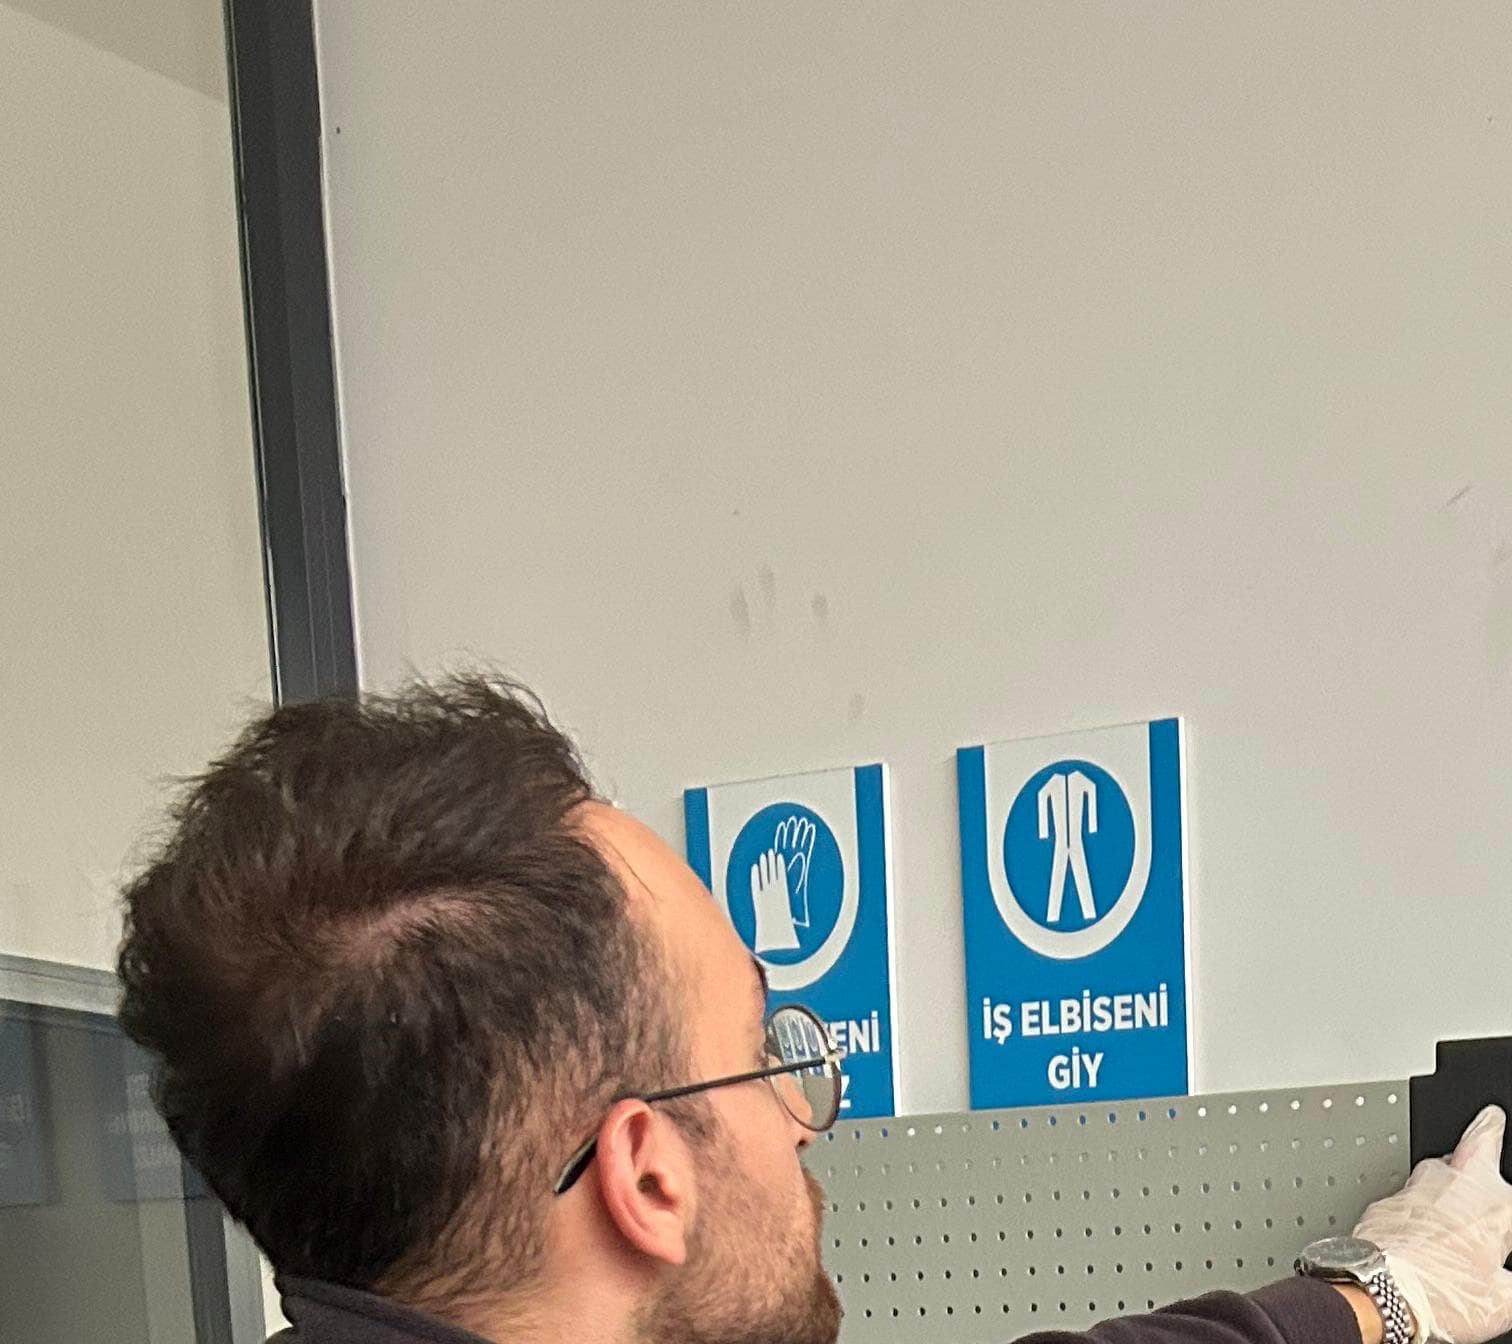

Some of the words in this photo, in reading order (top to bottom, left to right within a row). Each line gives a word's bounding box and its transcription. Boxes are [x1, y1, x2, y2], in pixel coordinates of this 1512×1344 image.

[983, 997, 1013, 1045] İŞ
[1020, 986, 1169, 1037] ELBİSENİ
[1047, 1046, 1104, 1090] GİY
